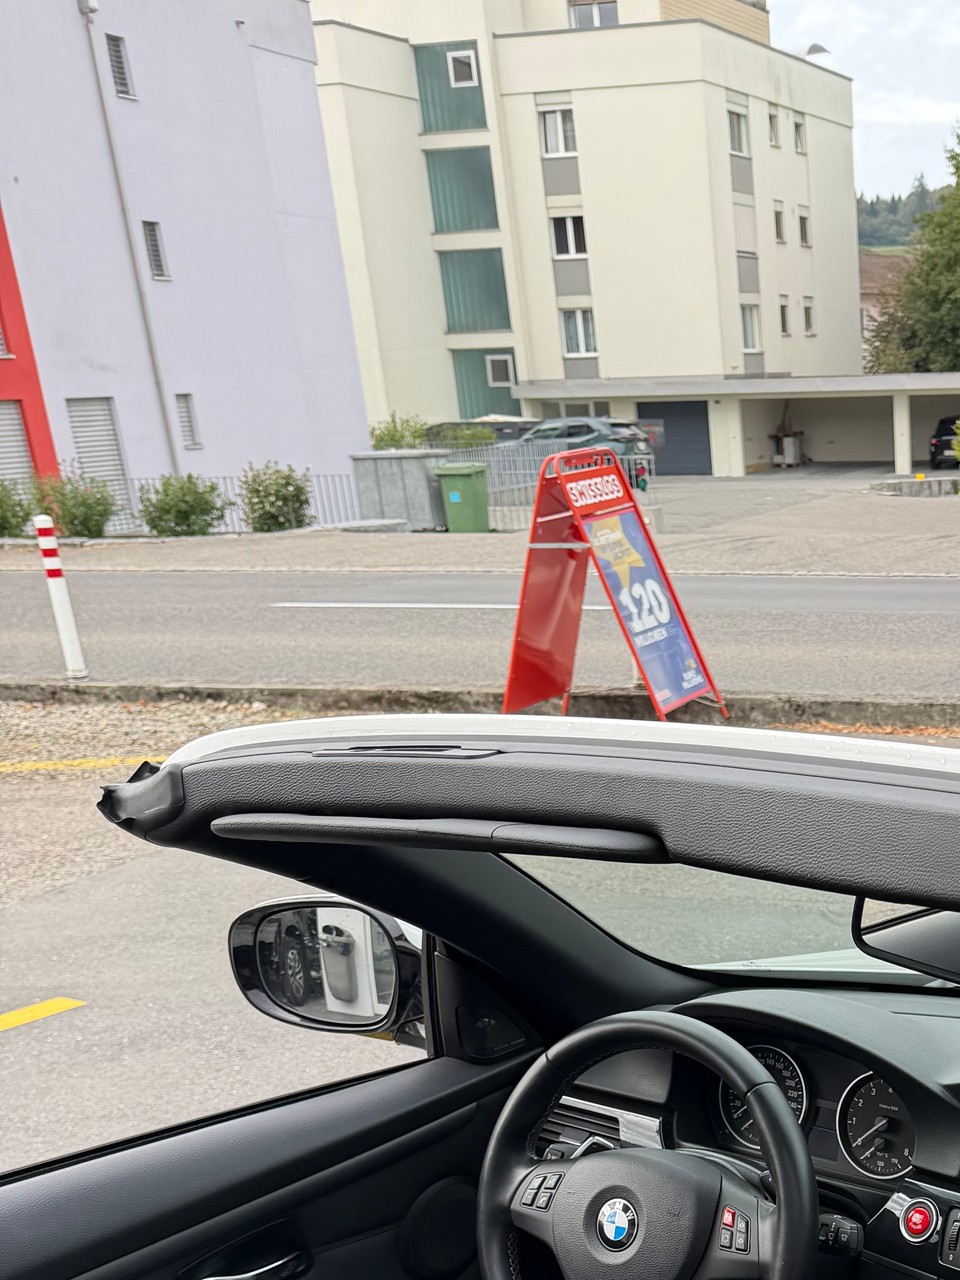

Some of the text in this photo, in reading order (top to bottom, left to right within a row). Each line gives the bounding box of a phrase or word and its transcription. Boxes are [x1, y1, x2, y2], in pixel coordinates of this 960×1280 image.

[619, 579, 670, 634] 120
[785, 1079, 796, 1087] 200
[787, 1089, 798, 1098] 220
[870, 1087, 876, 1096] 3
[858, 1099, 863, 1107] 2
[903, 1148, 909, 1156] 8
[602, 1201, 635, 1220] BMW
